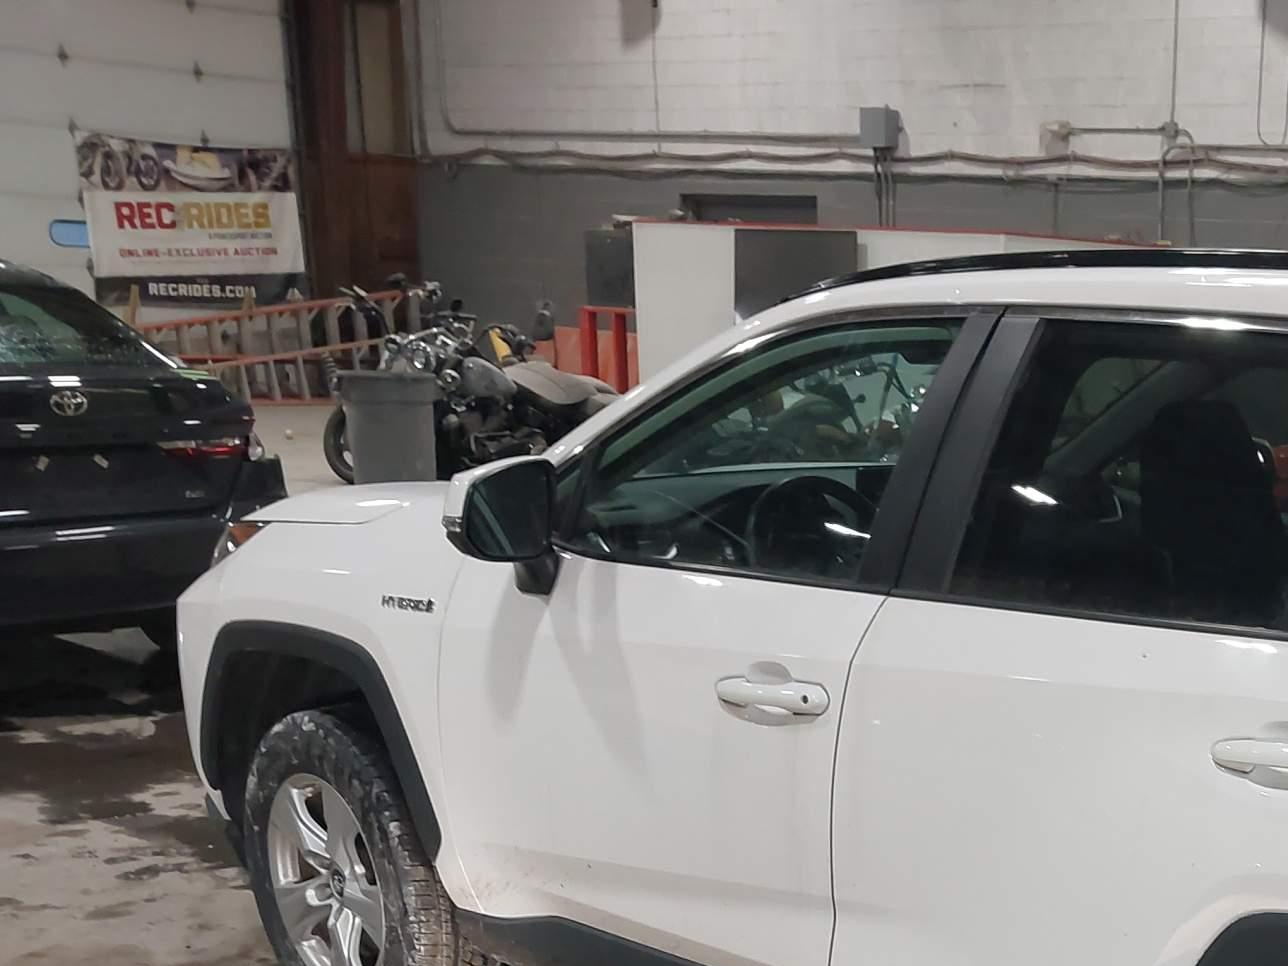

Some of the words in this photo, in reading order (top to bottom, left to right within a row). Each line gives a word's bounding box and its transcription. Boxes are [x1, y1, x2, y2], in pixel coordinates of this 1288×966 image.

[114, 201, 177, 230] REC
[182, 201, 273, 229] RIDES
[233, 247, 279, 257] AUCTION
